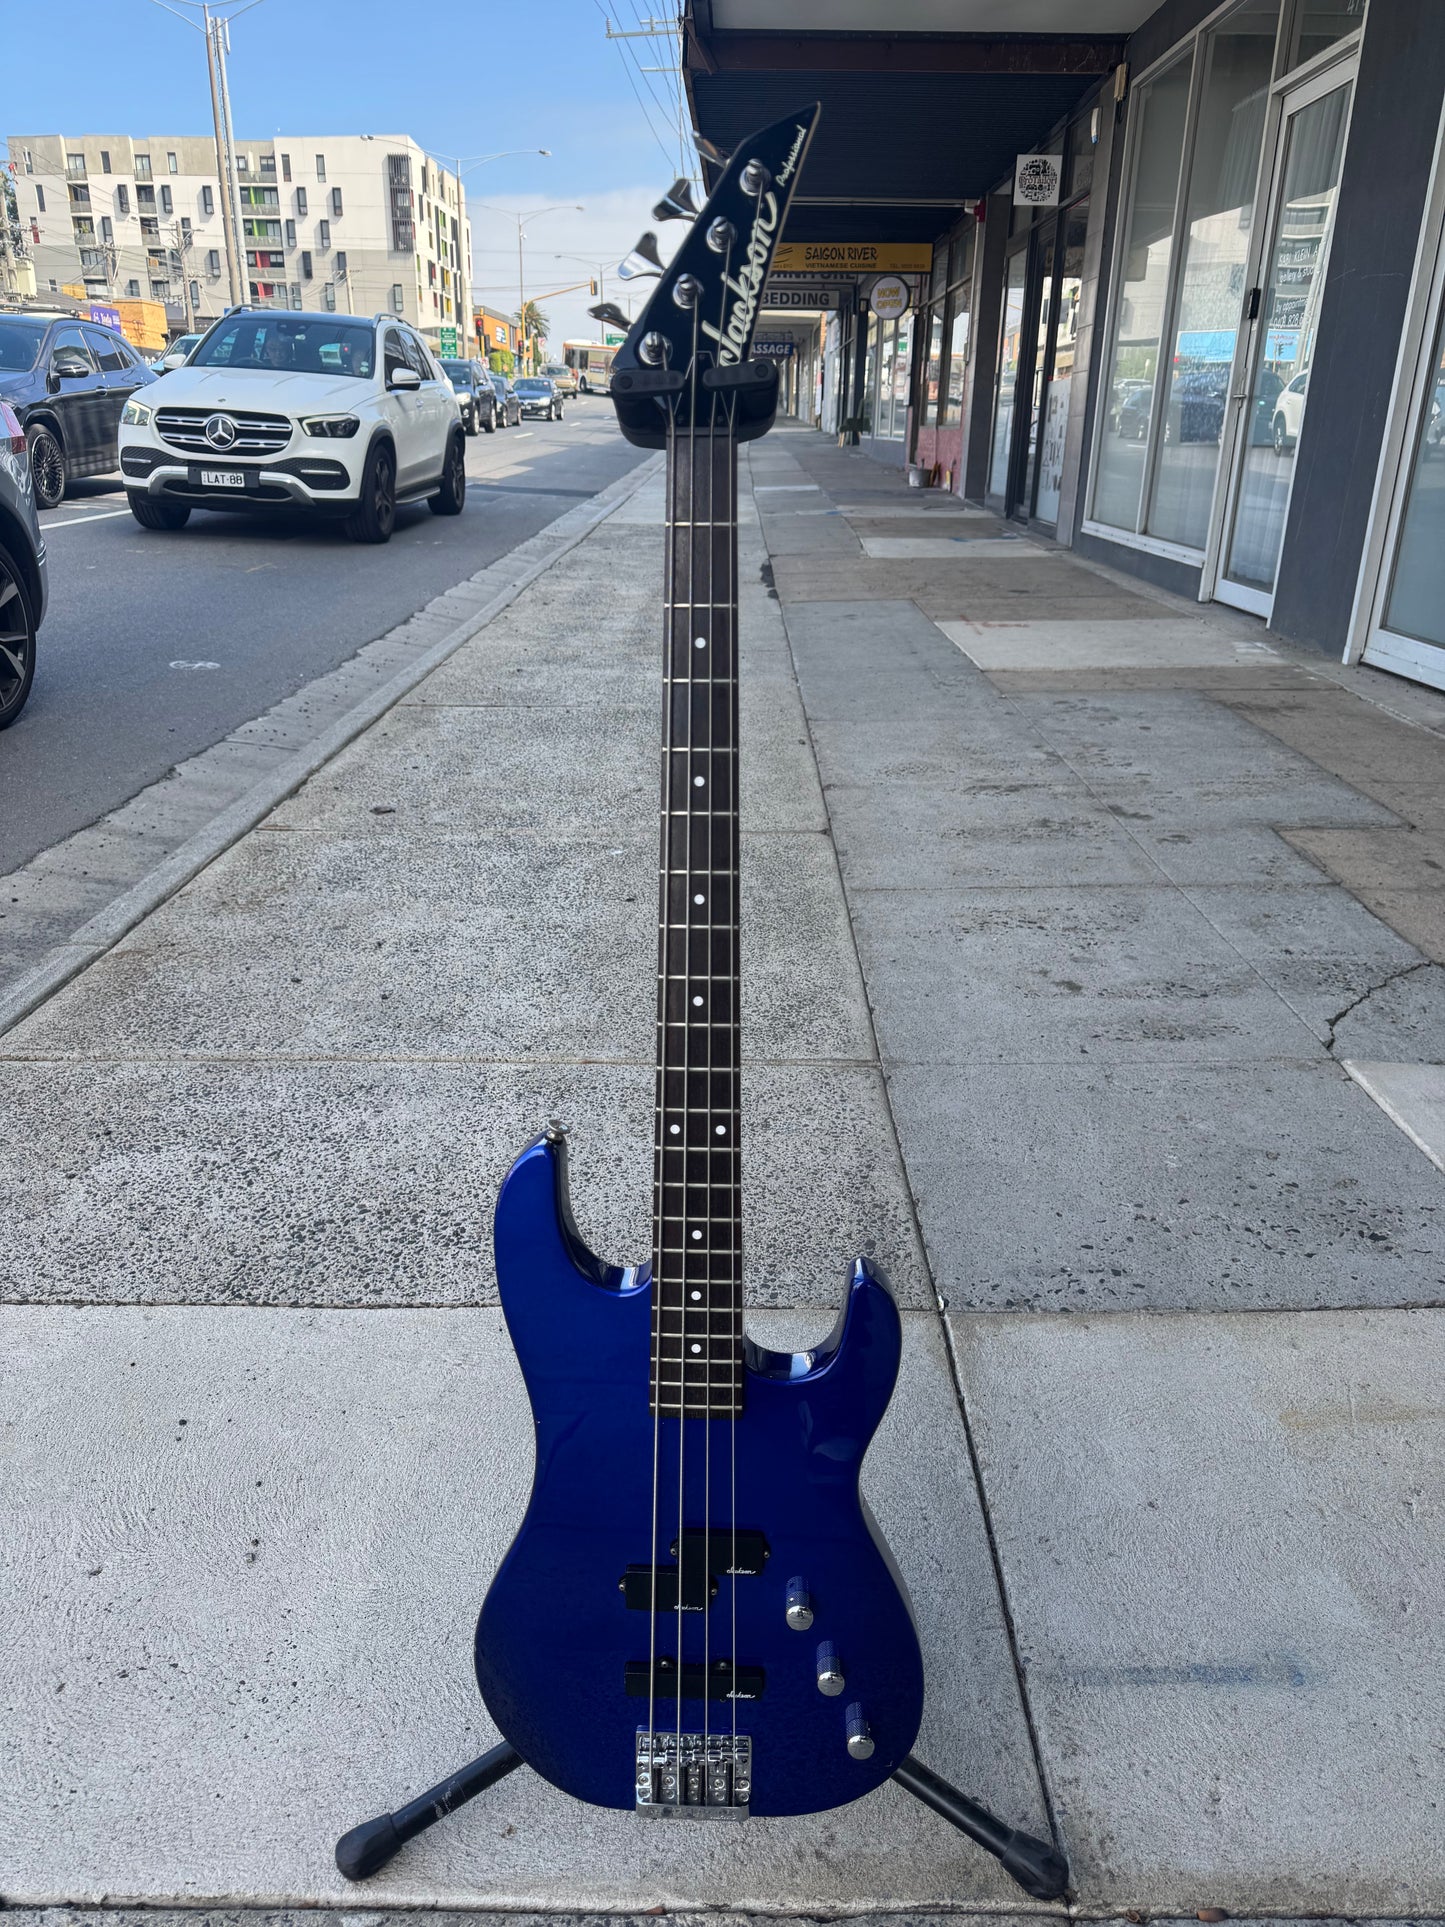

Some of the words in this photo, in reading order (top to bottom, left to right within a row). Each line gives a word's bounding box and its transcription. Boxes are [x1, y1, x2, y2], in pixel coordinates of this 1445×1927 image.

[776, 125, 807, 187] Professional
[805, 247, 845, 261] SAIGON
[848, 247, 878, 261] RIVER
[702, 191, 778, 367] Jackson
[762, 292, 830, 306] BEDDING
[753, 344, 790, 354] ASSAGE
